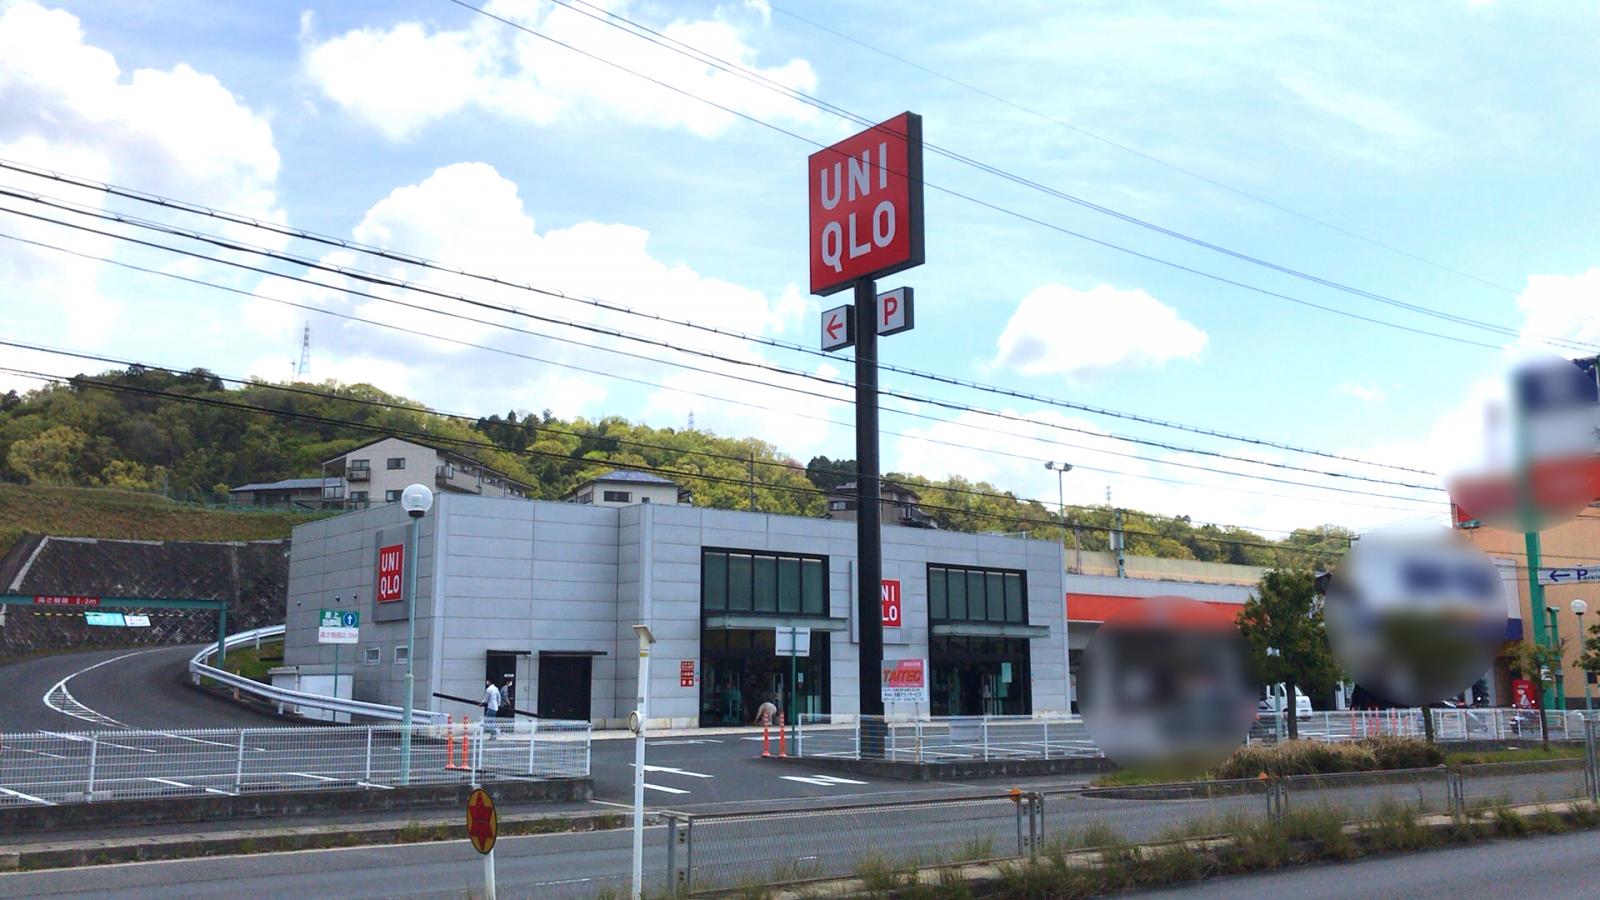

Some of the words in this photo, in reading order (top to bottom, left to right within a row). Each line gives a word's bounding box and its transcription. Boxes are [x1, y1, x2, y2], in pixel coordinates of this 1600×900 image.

[820, 142, 887, 210] UNI
[821, 200, 896, 273] QLO
[883, 296, 898, 326] P
[381, 551, 399, 572] UNI
[380, 574, 400, 599] QLO
[881, 584, 895, 602] NI
[881, 604, 898, 621] LO
